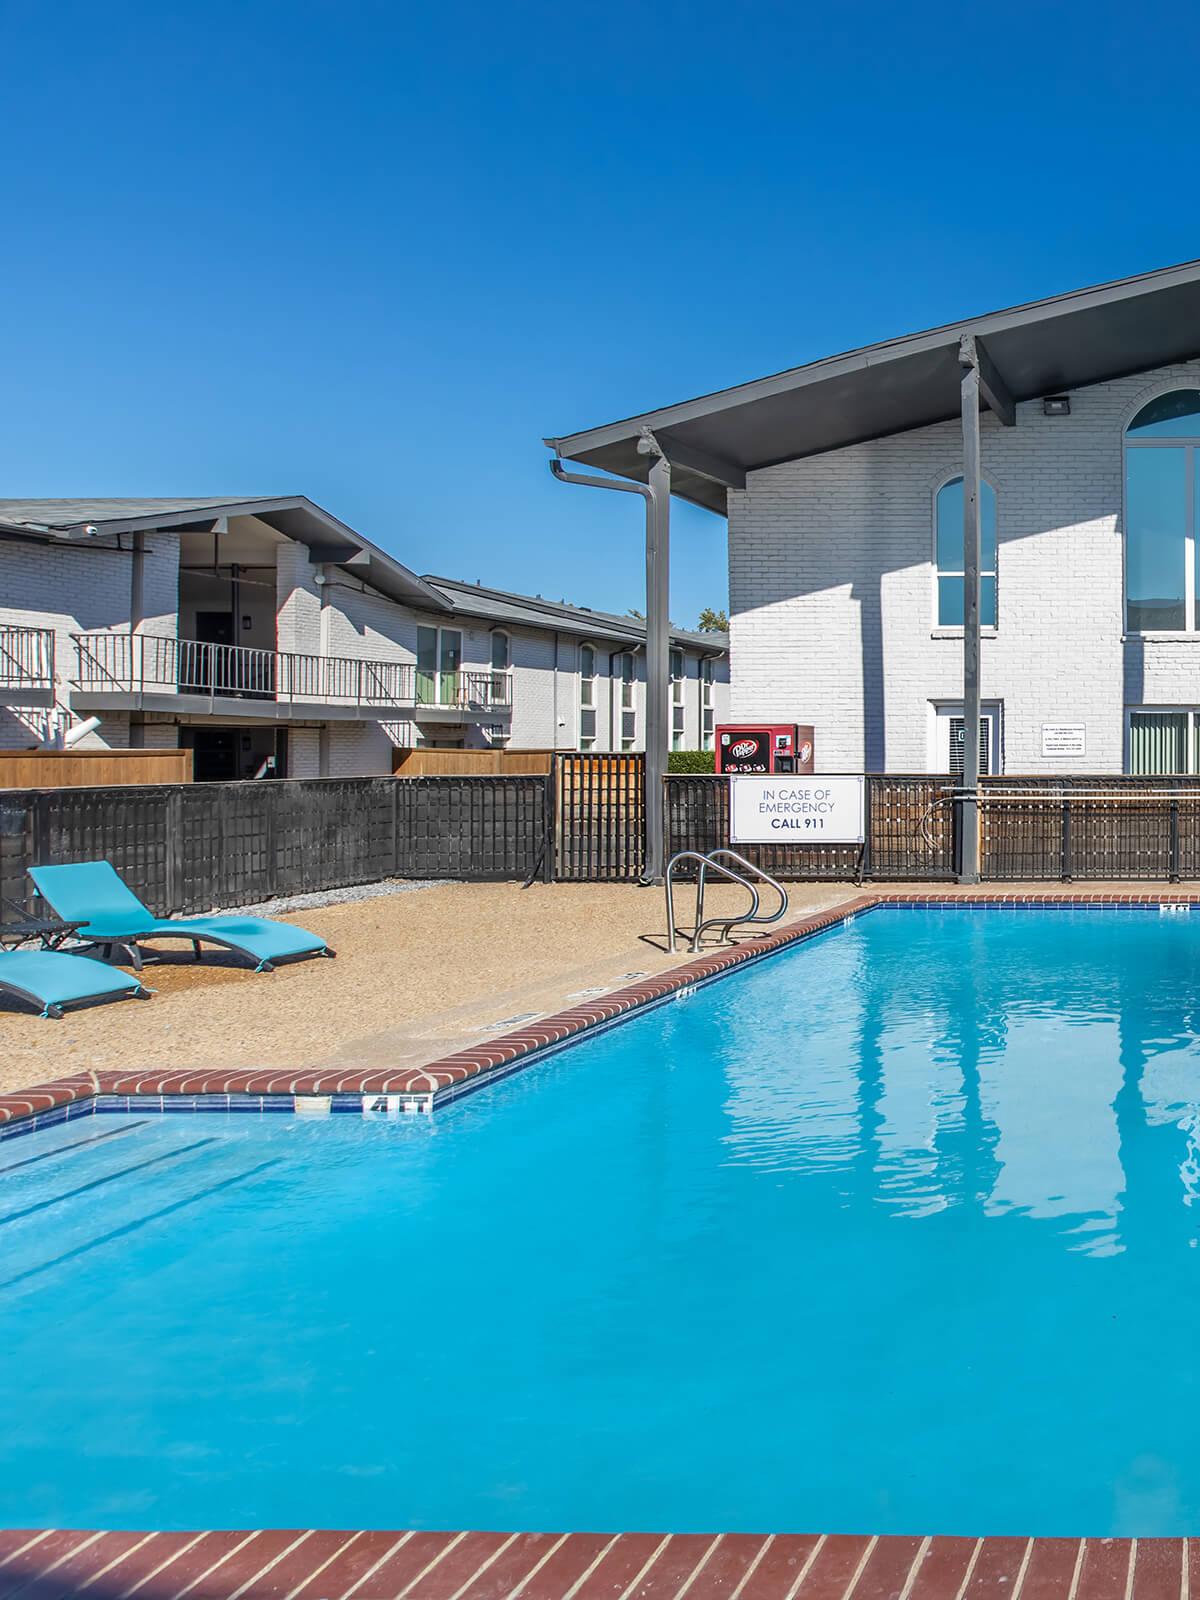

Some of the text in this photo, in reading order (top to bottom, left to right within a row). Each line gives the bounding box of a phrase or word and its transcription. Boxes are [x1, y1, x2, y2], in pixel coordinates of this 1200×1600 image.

[763, 790, 831, 800] IN CASE OF
[759, 803, 835, 813] EMERGENCY
[771, 818, 824, 829] CALL 911
[370, 1096, 429, 1112] 4 FT
